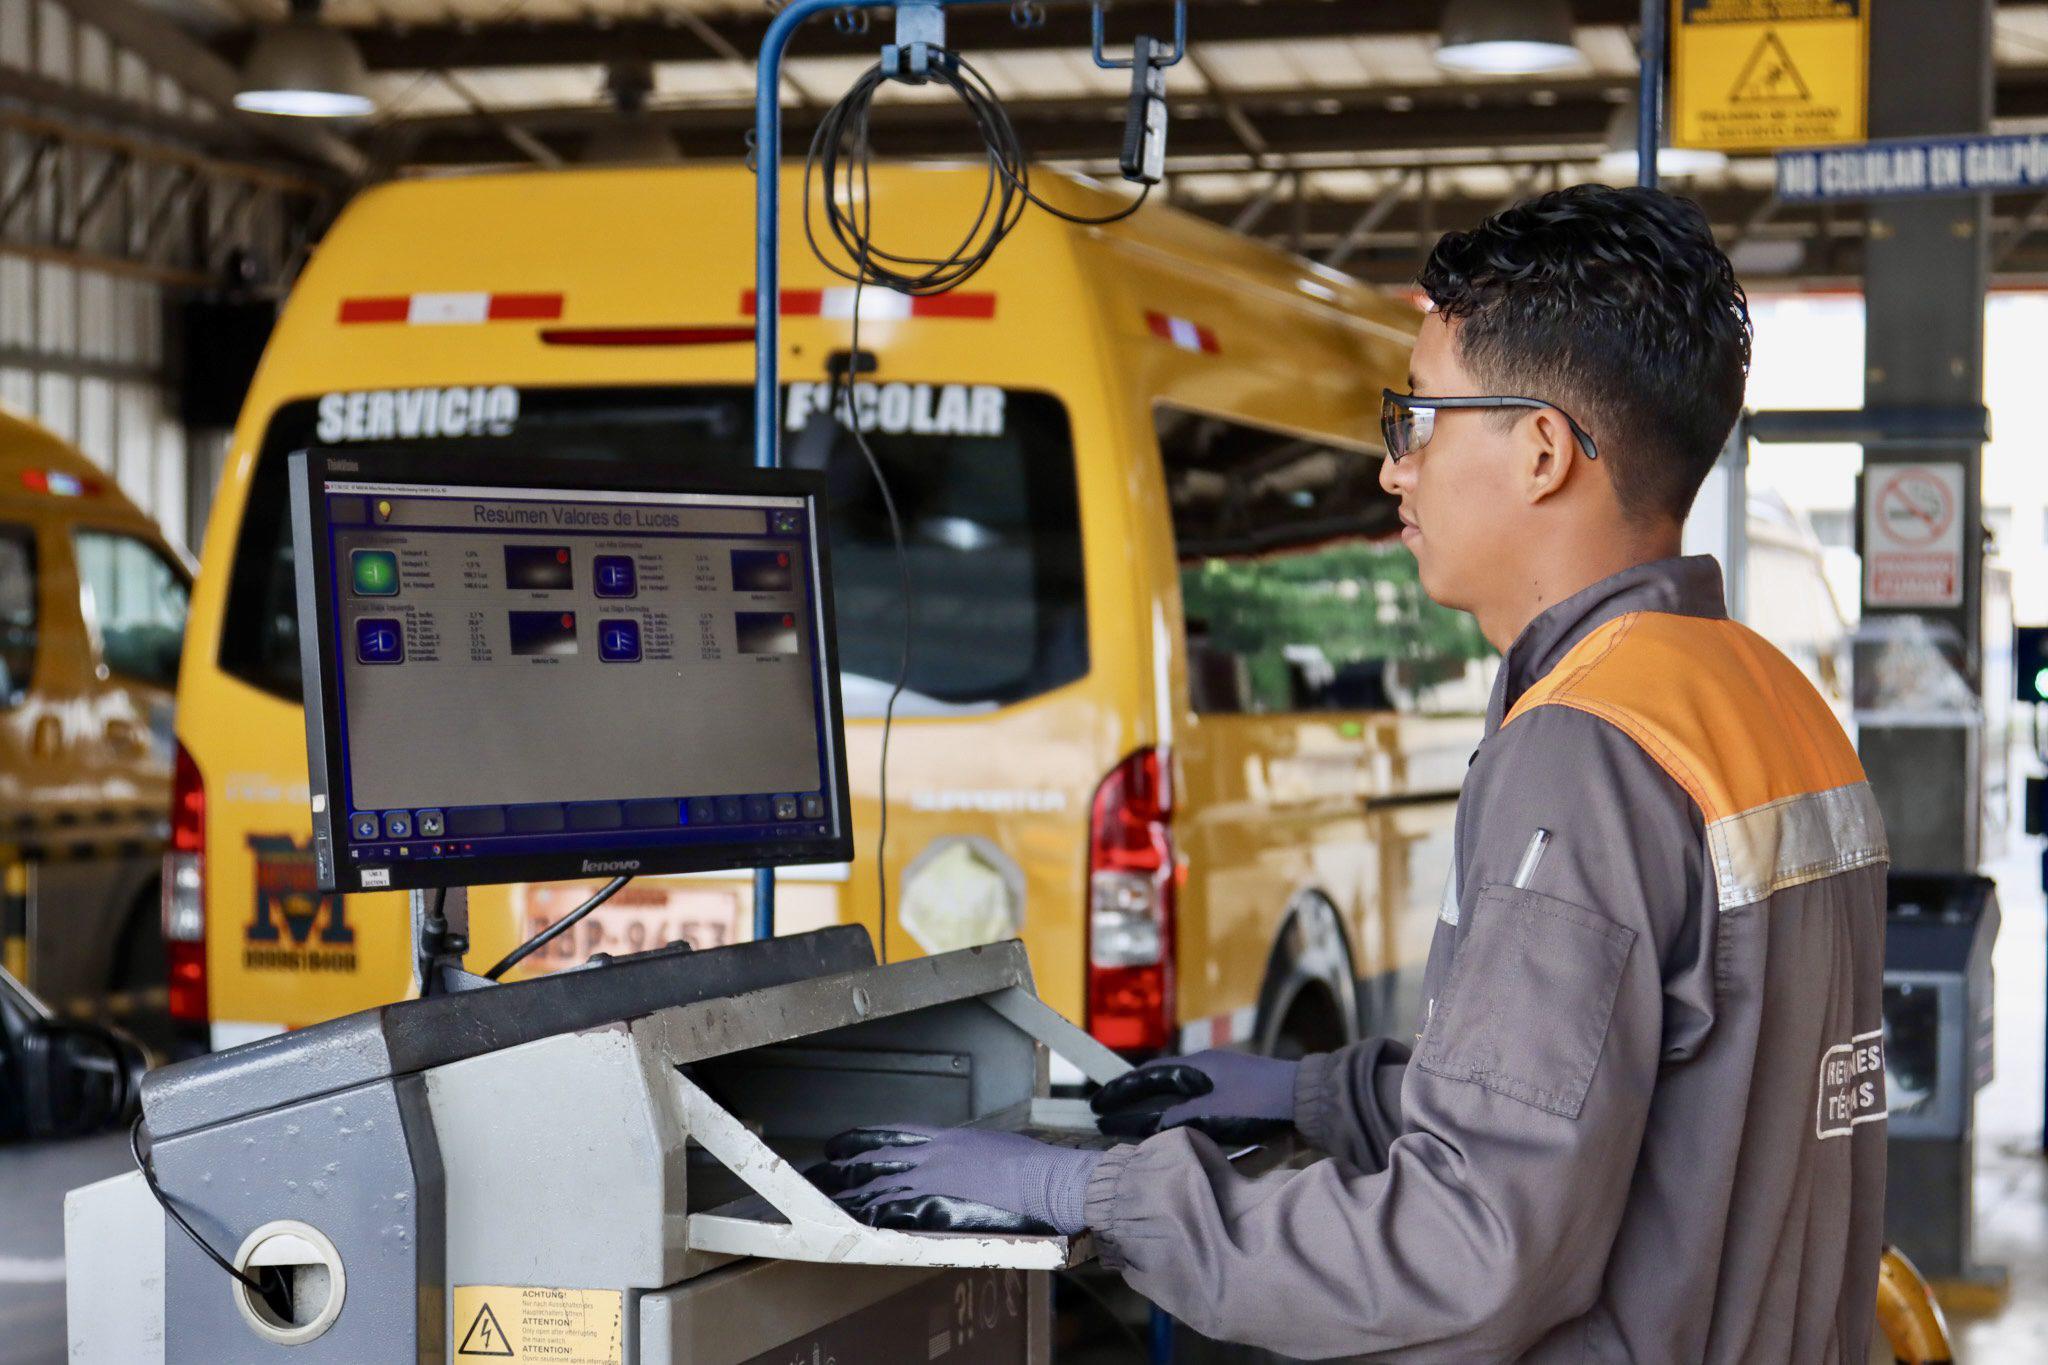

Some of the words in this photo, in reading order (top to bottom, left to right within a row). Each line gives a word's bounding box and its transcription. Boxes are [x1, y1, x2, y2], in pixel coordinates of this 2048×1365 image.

[317, 383, 520, 443] SERVICIO
[473, 504, 548, 524] Resúmen
[552, 507, 609, 527] Valores
[614, 509, 632, 527] de
[636, 510, 679, 528] Luces
[581, 859, 640, 872] lenovo
[522, 1290, 567, 1299] ACHTUNG!
[522, 1318, 572, 1327] ATTENTION!
[522, 1345, 572, 1354] ATTENTION!
